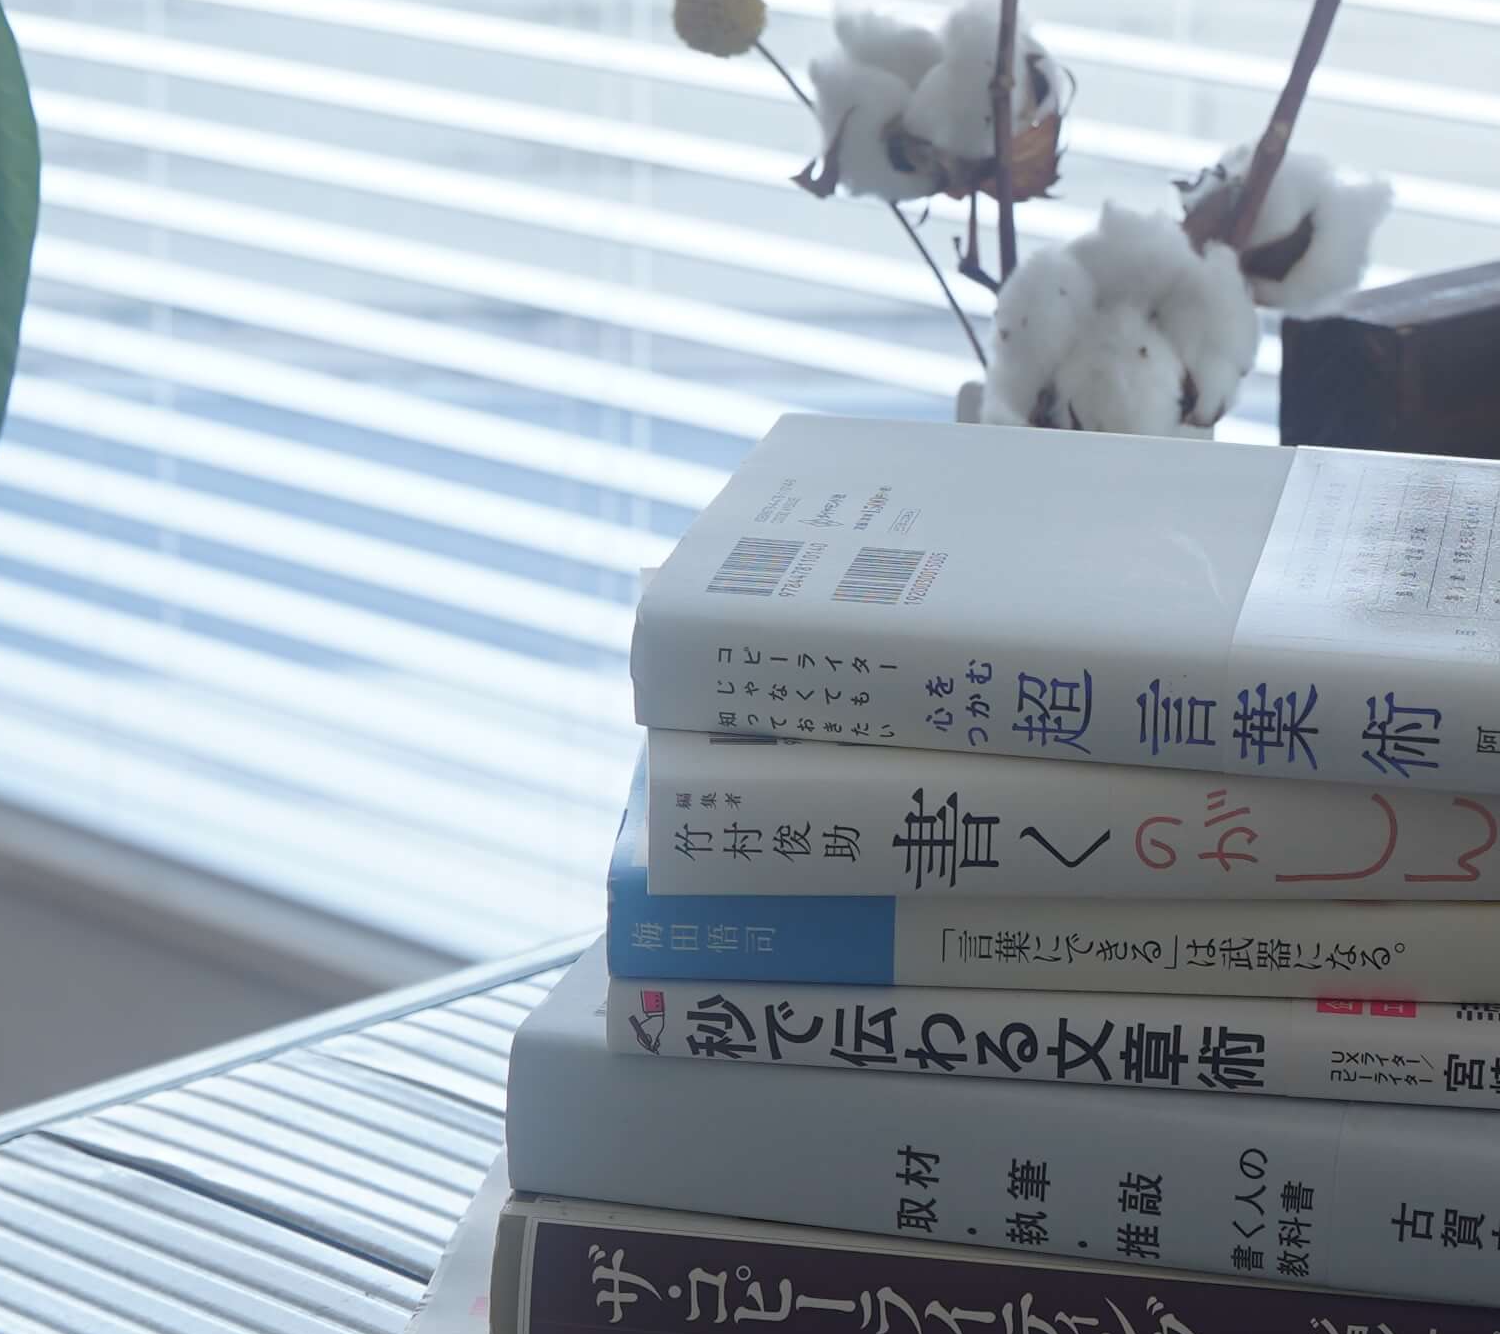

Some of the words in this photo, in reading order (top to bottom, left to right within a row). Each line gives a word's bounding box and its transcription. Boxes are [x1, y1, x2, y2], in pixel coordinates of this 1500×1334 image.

[717, 646, 899, 671] コピーライター
[717, 680, 871, 707] じゃなくても
[924, 675, 955, 733] 心を
[965, 659, 993, 747] つかむ
[717, 711, 897, 740] 知っておきたい
[1012, 668, 1442, 779] 超言葉術
[674, 790, 743, 811] 編集者
[674, 820, 861, 863] 竹村俊助
[631, 921, 777, 955] 梅田悟司
[942, 927, 1406, 971] 「言葉にできる」は武器になる。
[684, 993, 1266, 1090] 秒で伝わる文章術
[1330, 1070, 1434, 1086] コピーライター
[1230, 1147, 1270, 1272] 書く人の
[1276, 1180, 1316, 1278] 教科書
